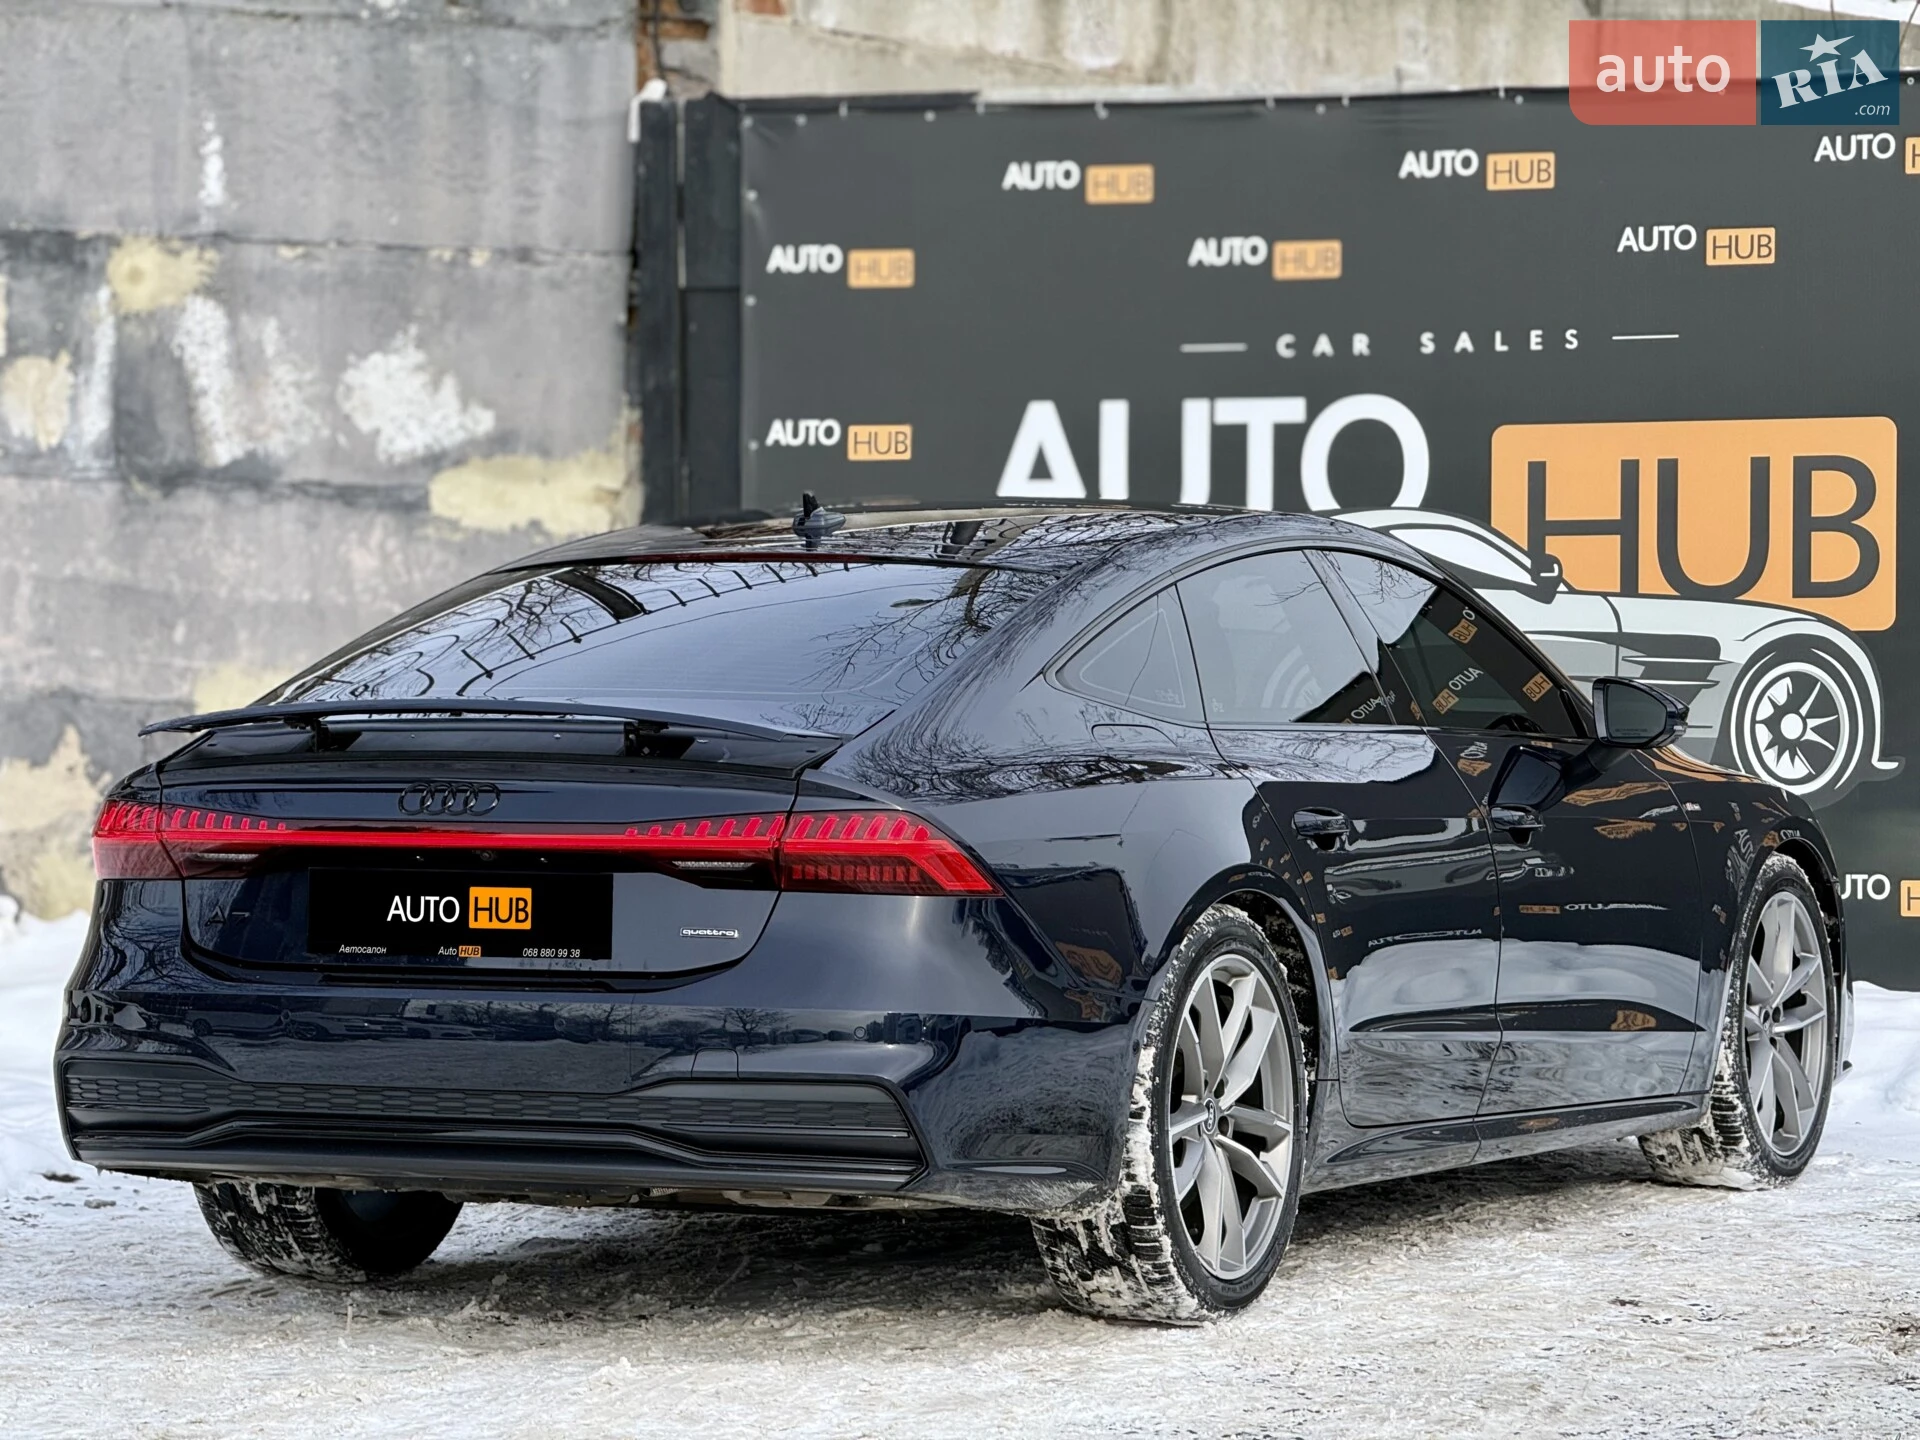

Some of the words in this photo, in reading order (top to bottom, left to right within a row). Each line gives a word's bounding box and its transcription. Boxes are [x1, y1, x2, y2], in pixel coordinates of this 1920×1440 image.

[1813, 133, 1897, 163] AUTO
[1002, 159, 1081, 191] AUTO
[1092, 170, 1151, 198] HUB
[1399, 148, 1480, 180] AUTO
[1492, 158, 1553, 187] HUB
[1188, 236, 1268, 267] AUTO
[1278, 244, 1340, 273] HUB
[1617, 224, 1697, 253] AUTO
[1711, 232, 1773, 261] HUB
[766, 244, 844, 274] AUTO
[853, 254, 912, 282] HUB
[1275, 333, 1371, 359] CAR
[1419, 328, 1580, 354] SALES
[765, 418, 841, 447] AUTO
[853, 430, 909, 455] HUB
[996, 393, 1430, 511] AUTO
[1527, 454, 1881, 600] HUB
[386, 895, 460, 922] AUTO
[473, 896, 530, 924] HUB
[339, 944, 387, 954] Автосалон
[681, 928, 736, 937] quattro
[438, 946, 458, 956] Auto
[459, 946, 481, 957] HUB
[522, 947, 539, 957] 068
[540, 948, 556, 958] 880
[557, 948, 568, 958] 99
[569, 948, 581, 958] 38
